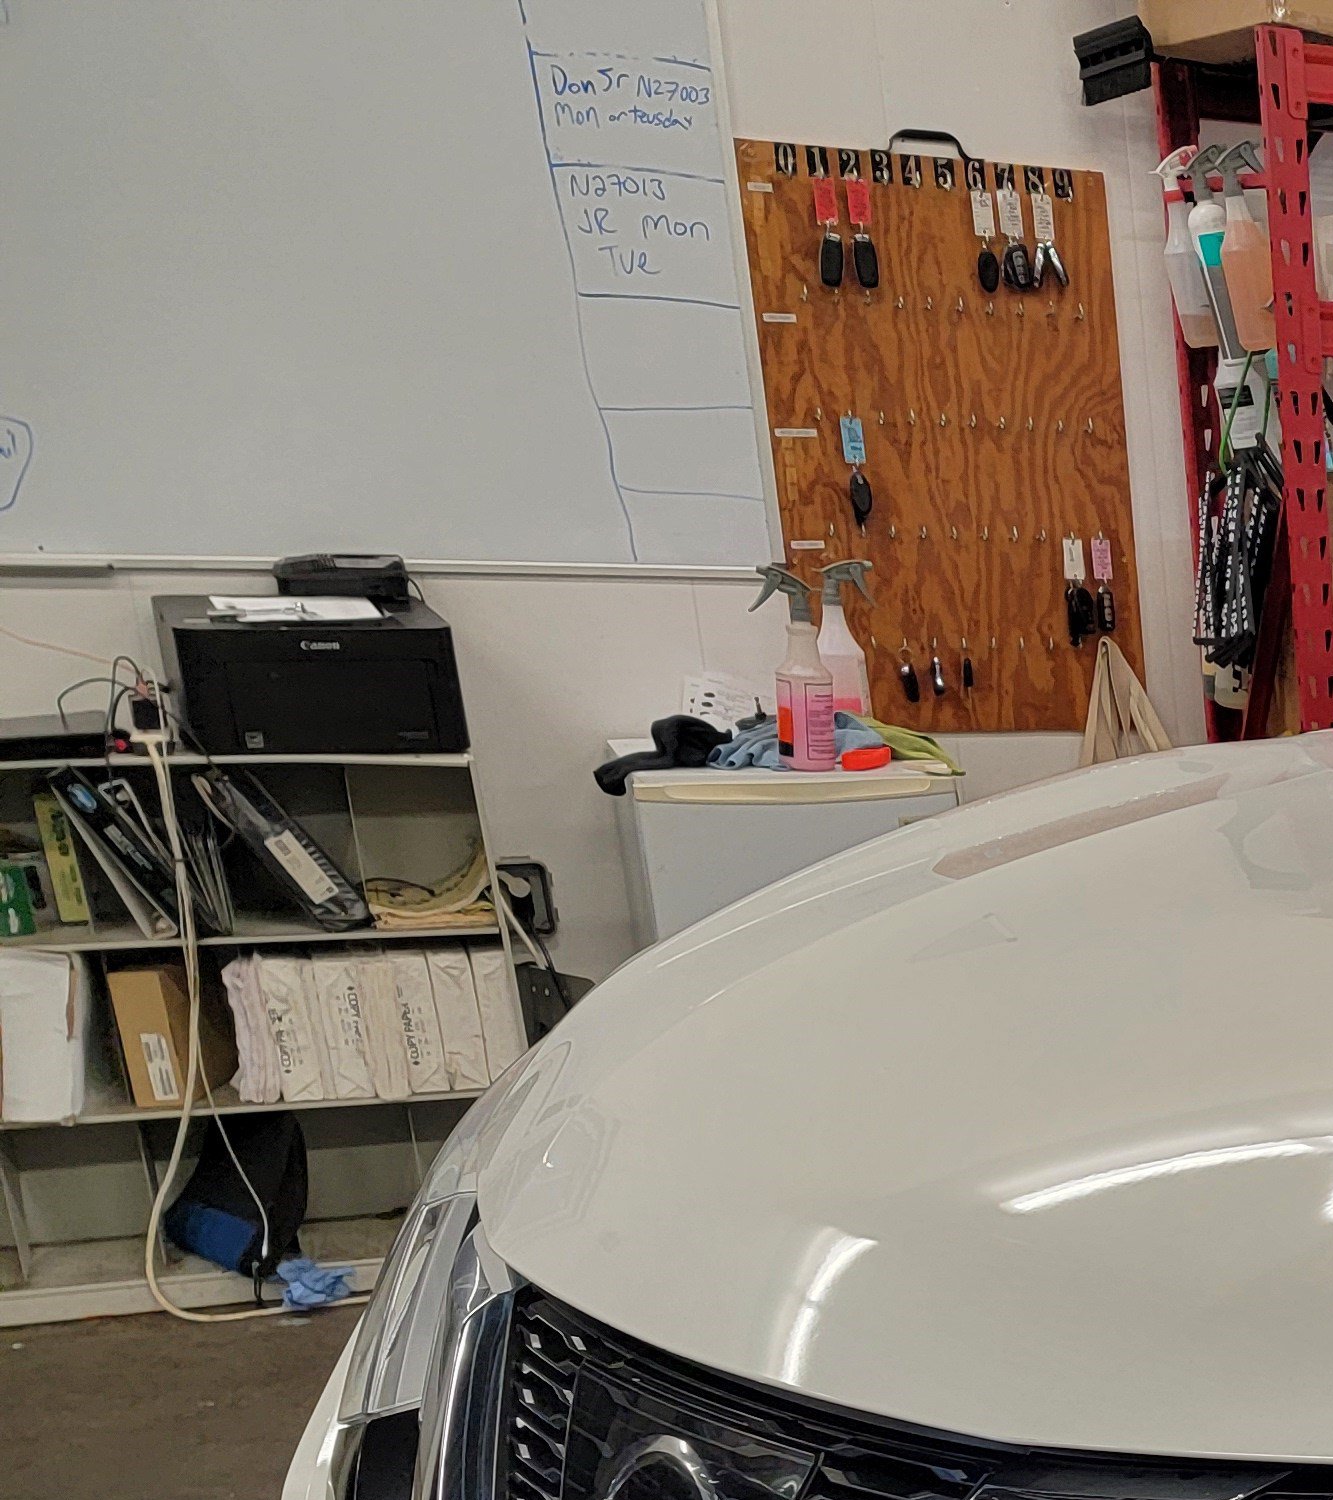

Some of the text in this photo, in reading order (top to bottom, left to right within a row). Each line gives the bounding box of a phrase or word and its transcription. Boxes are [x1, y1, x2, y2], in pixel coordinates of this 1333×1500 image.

[550, 64, 596, 95] Don
[636, 74, 710, 105] N27003
[555, 101, 600, 128] Mon
[842, 151, 859, 179] 2
[874, 153, 889, 182] 3
[904, 156, 920, 185] 4
[937, 159, 952, 189] 5
[967, 160, 983, 190] 6
[997, 163, 1013, 190] 7
[570, 173, 666, 201] N27013
[578, 208, 710, 242] JR Mon
[300, 640, 340, 650] Canon
[406, 1035, 419, 1059] COPY
